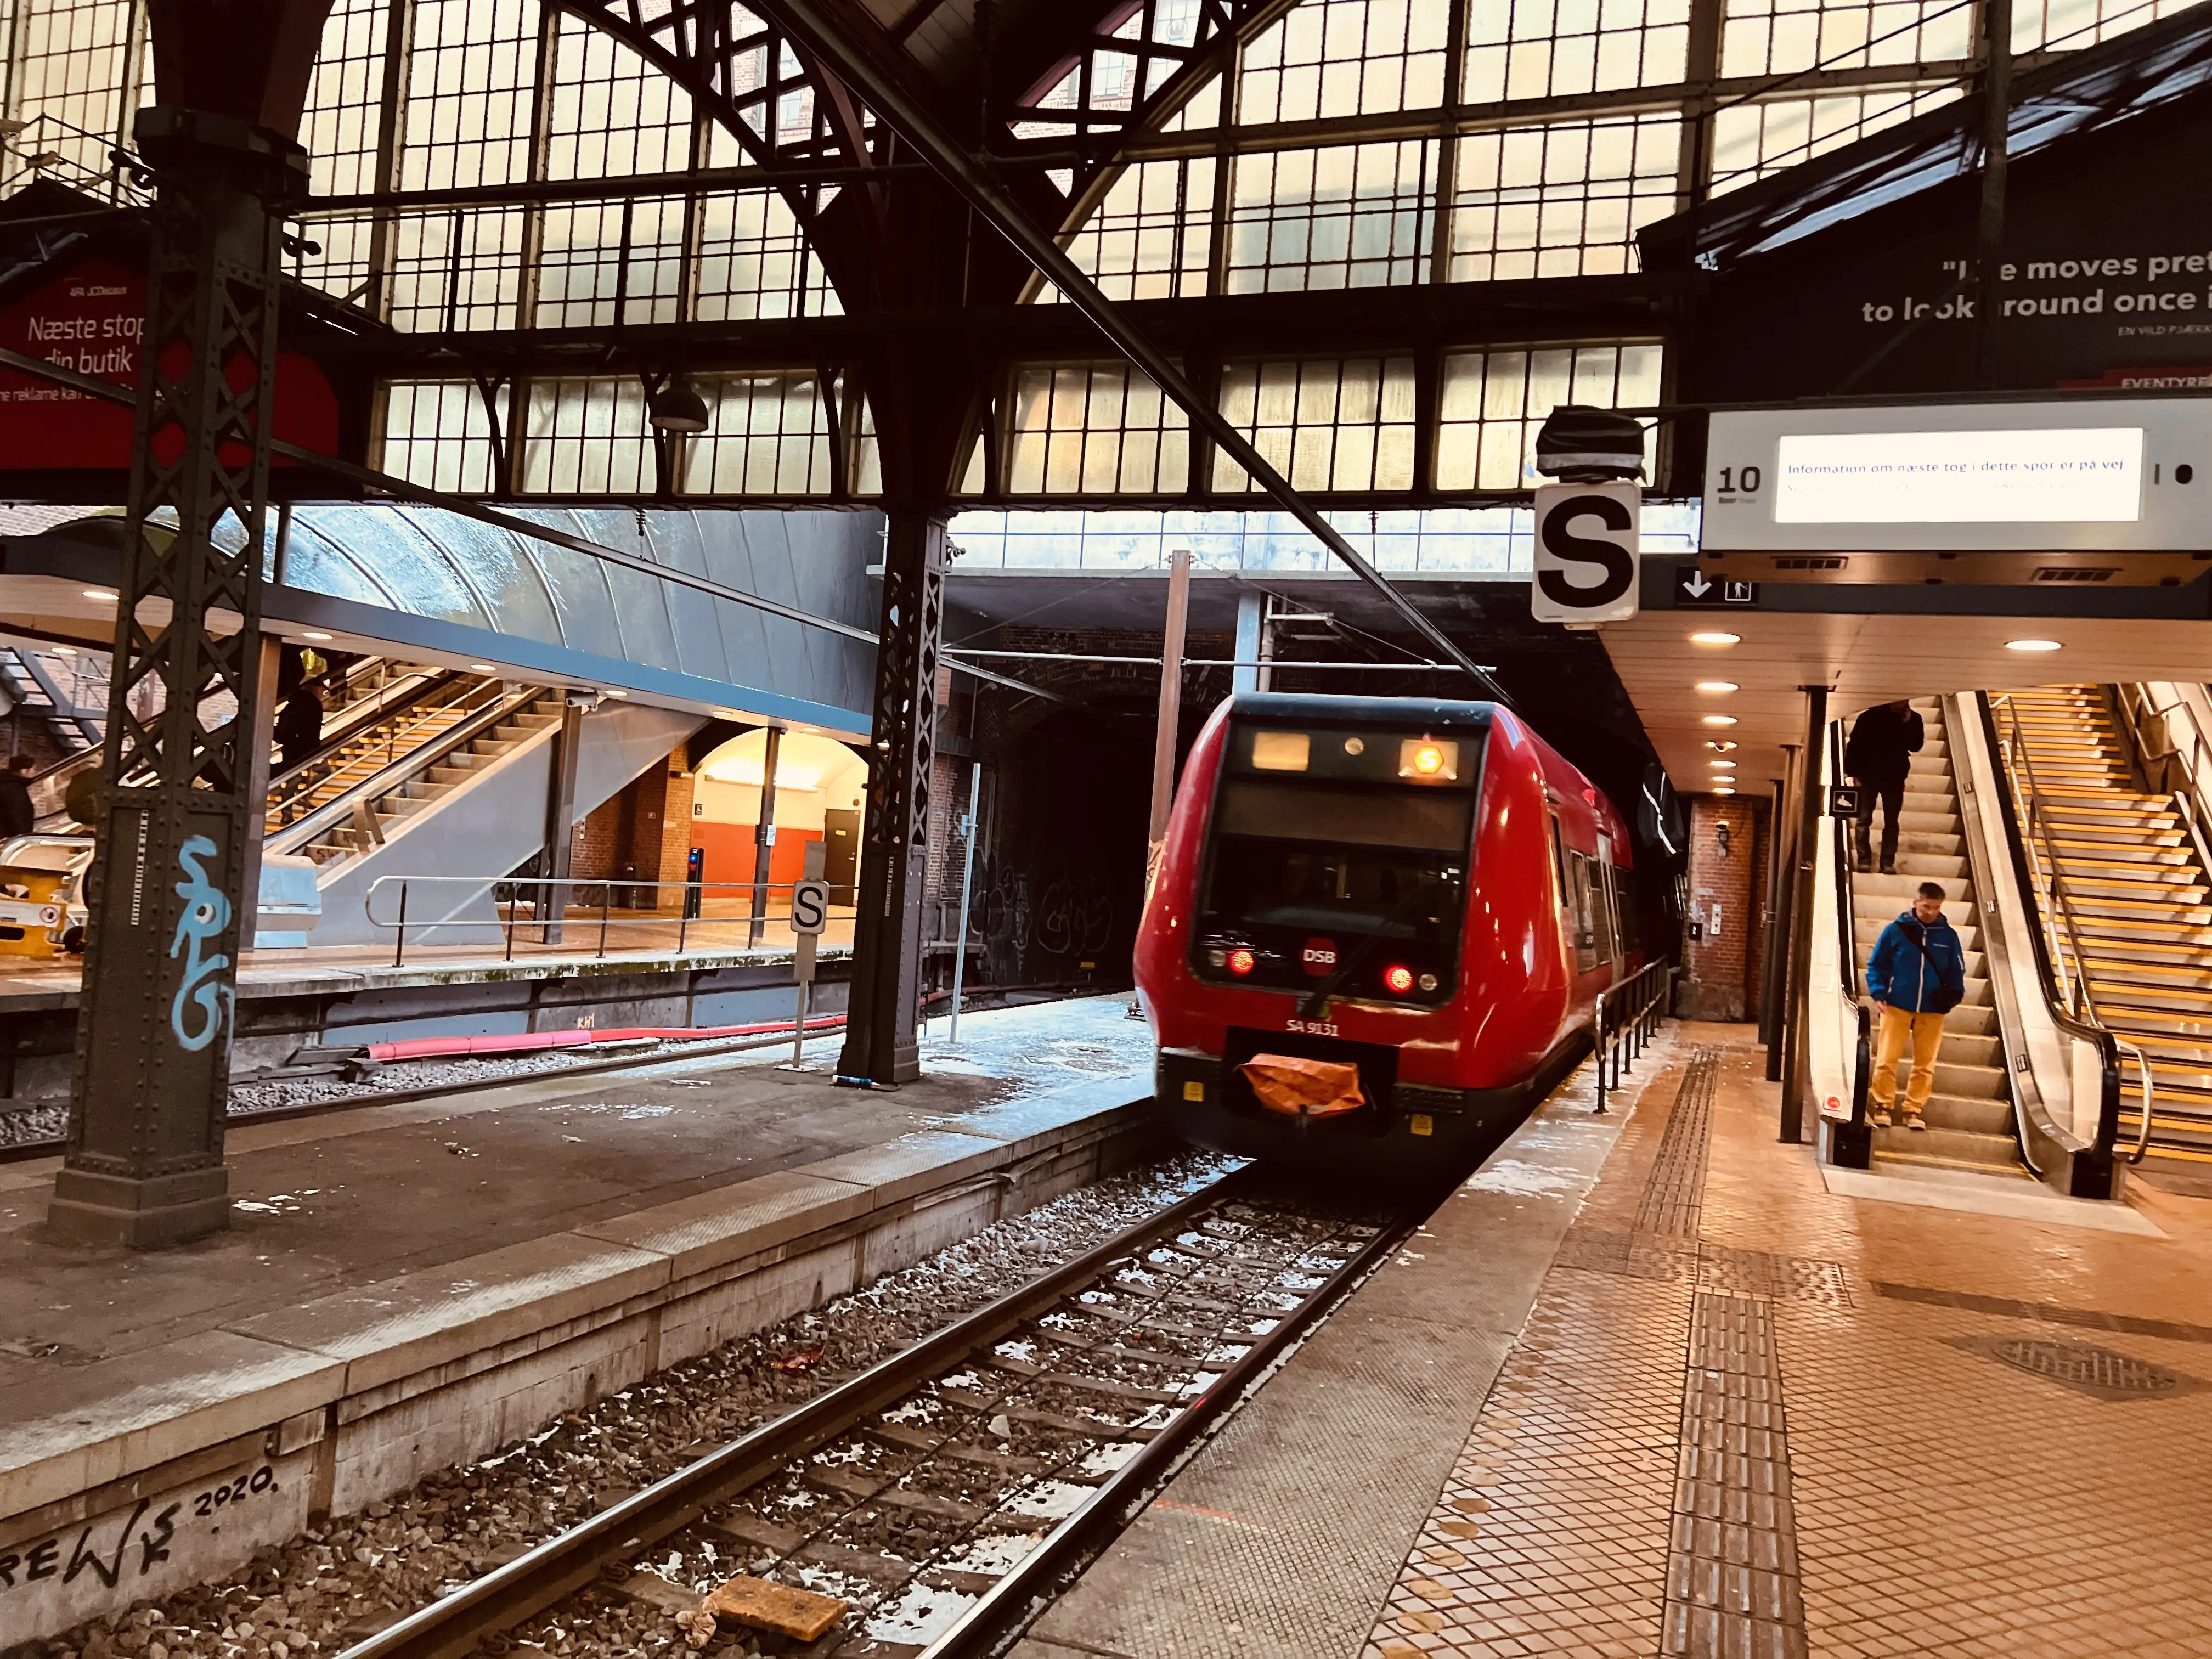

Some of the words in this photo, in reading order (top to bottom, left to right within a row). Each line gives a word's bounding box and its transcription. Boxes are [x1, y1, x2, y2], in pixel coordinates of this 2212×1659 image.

[2028, 258, 2138, 281] moves
[1861, 302, 1894, 323] to
[1997, 288, 2104, 318] round
[2114, 292, 2197, 312] once
[27, 315, 97, 341] Næste
[78, 345, 134, 374] butik
[1717, 466, 1760, 493] 10
[1788, 464, 1866, 474] Information
[1871, 465, 1893, 473] om
[1898, 464, 1939, 472] næste
[1944, 463, 1967, 473] tog
[1980, 461, 2018, 471] dette
[2023, 462, 2055, 472] spor
[2059, 462, 2074, 470] er
[2079, 459, 2097, 471] på
[2102, 459, 2124, 471] vej
[1538, 495, 1634, 608] S
[1421, 751, 1437, 769] S
[795, 886, 823, 928] S
[1303, 949, 1336, 963] DSB
[1286, 1019, 1305, 1032] SA
[1306, 1022, 1340, 1037] 9131
